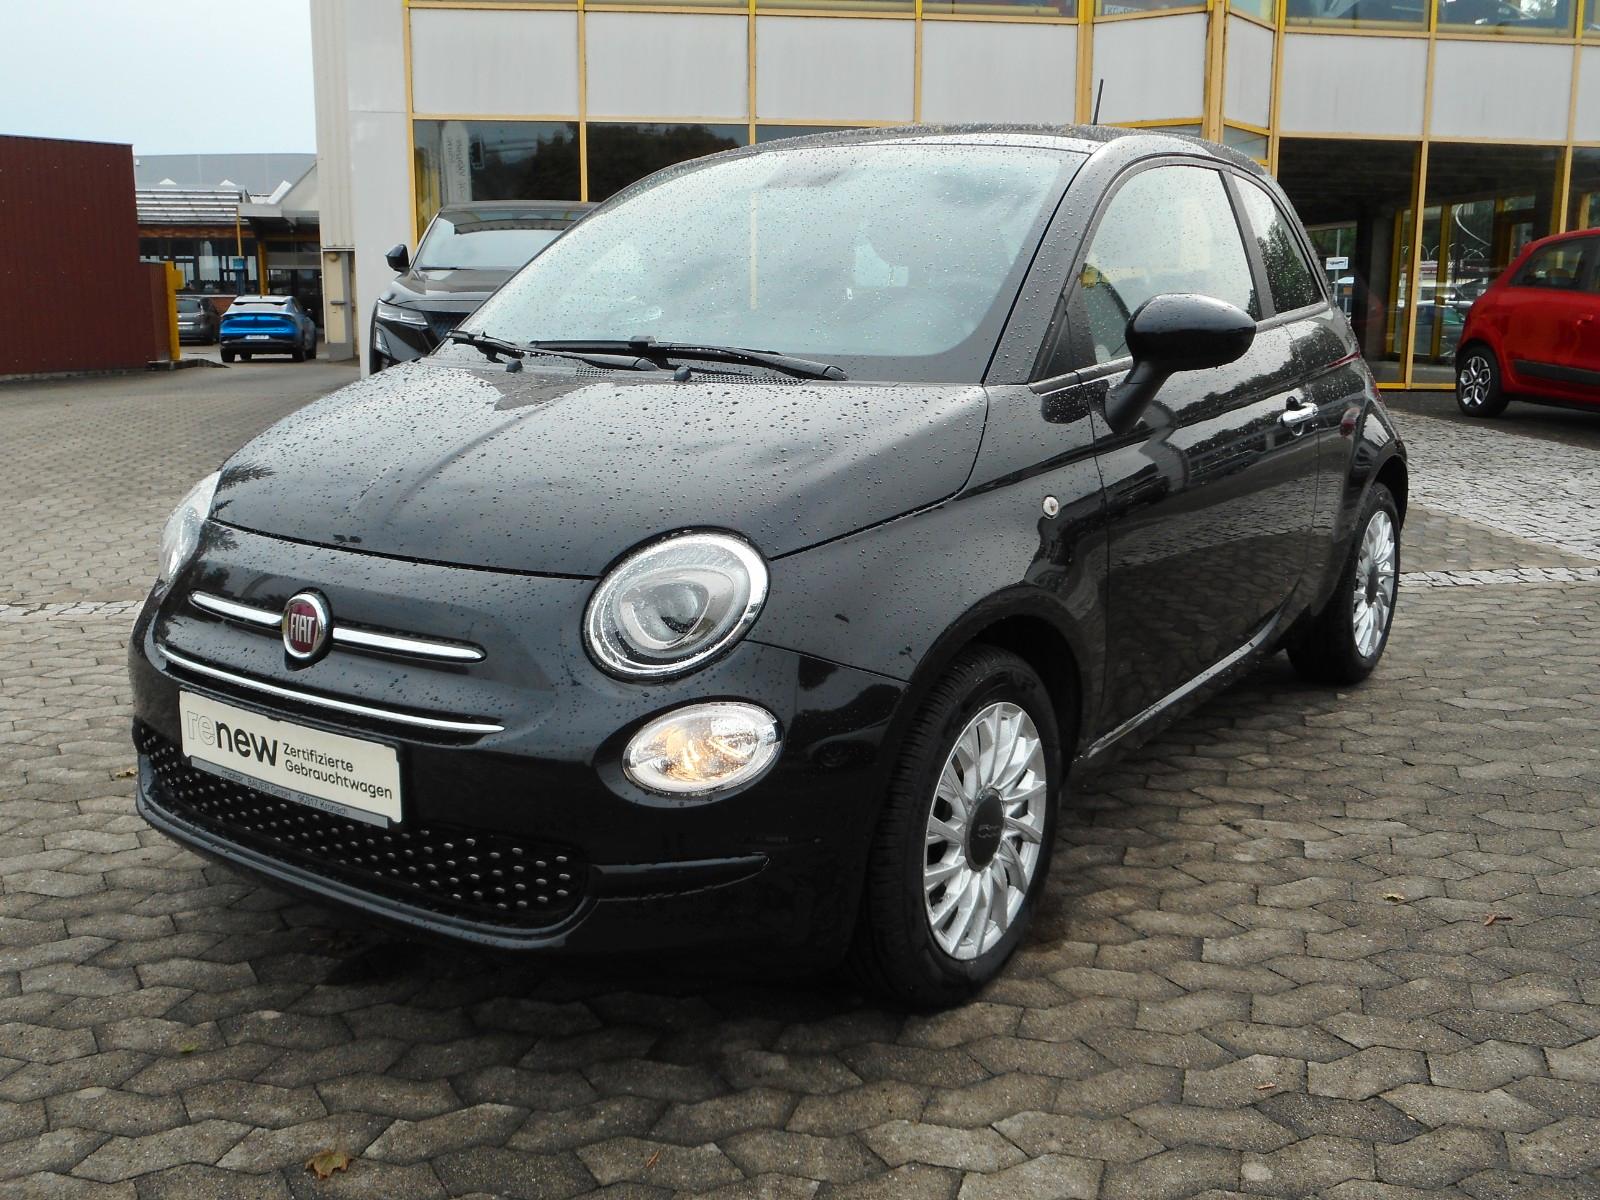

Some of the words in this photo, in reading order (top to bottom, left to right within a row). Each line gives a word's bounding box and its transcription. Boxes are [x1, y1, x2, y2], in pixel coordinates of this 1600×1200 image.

[290, 613, 315, 644] FIAT
[186, 710, 278, 767] renew
[283, 742, 354, 773] Zertifizierte
[285, 759, 393, 800] Gebrauchtwagen
